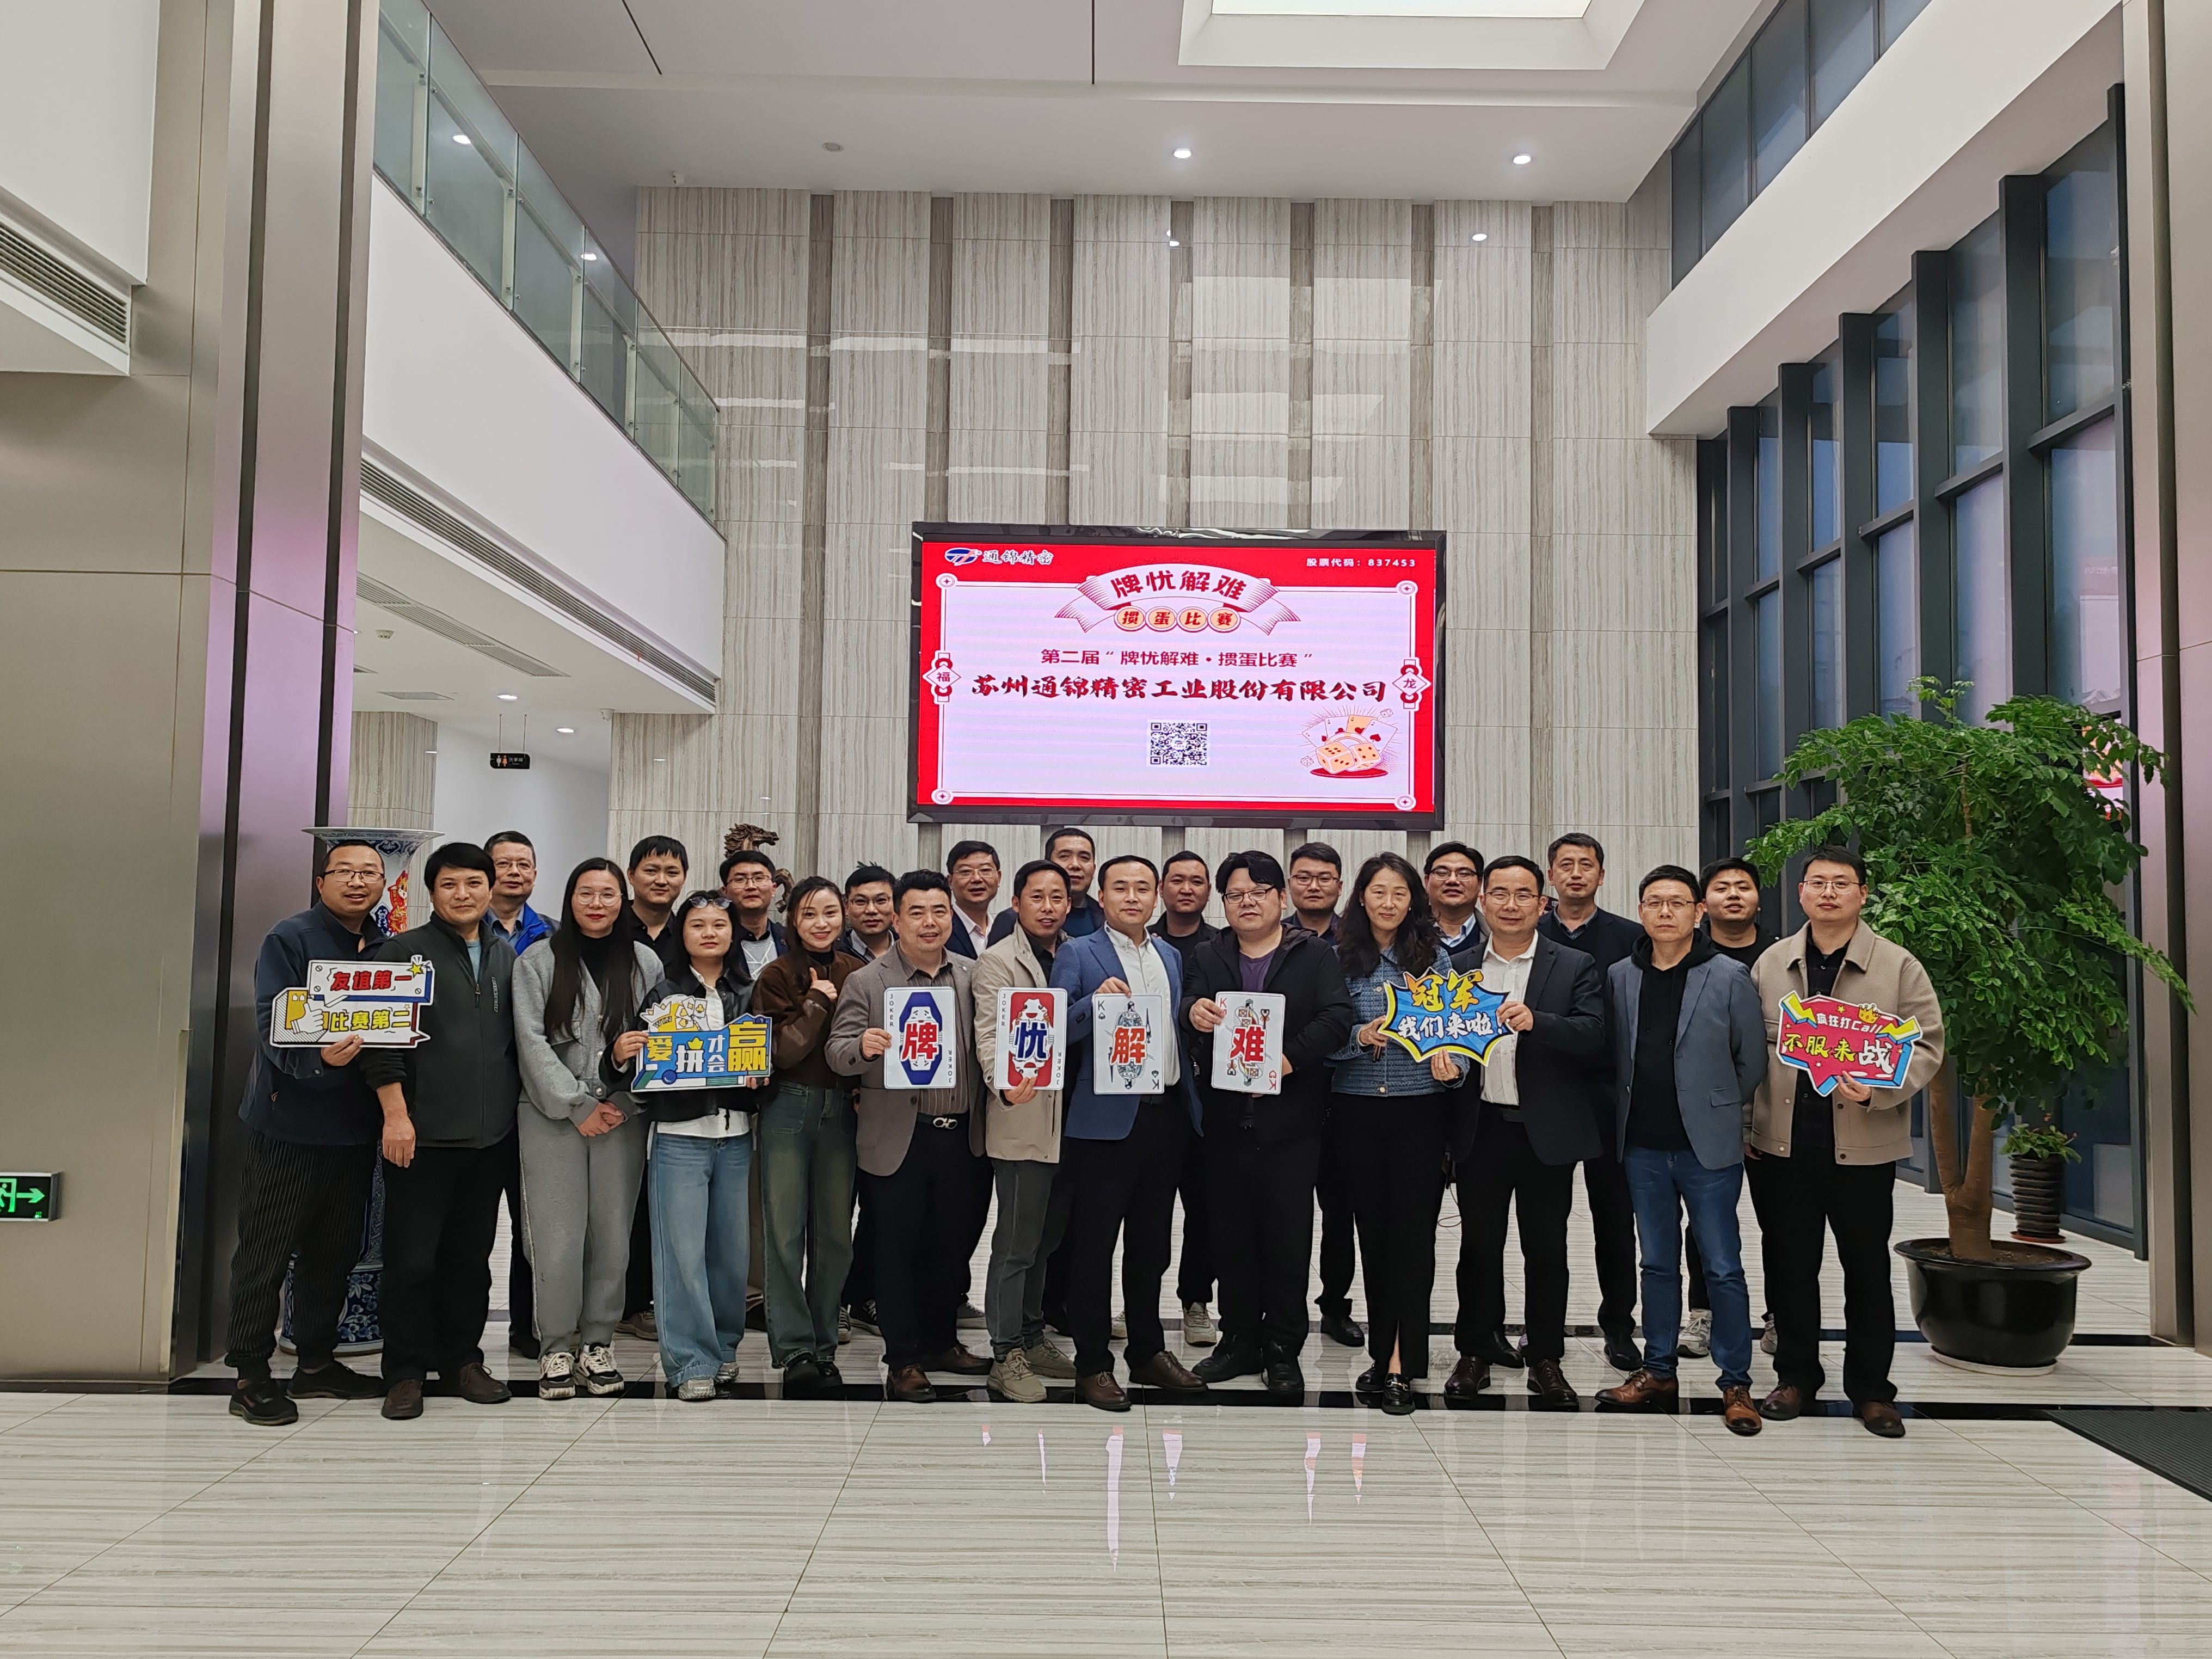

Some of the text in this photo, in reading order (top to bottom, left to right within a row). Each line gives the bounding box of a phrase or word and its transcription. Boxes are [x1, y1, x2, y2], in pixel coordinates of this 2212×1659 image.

[982, 549, 1054, 565] 通锦精密
[1110, 570, 1247, 600] 牌忧解难
[1122, 611, 1233, 626] 掼蛋比赛
[936, 671, 950, 682] 福
[1403, 678, 1417, 689] 龙
[972, 674, 1386, 702] 苏州通锦精密工业股份有限公司
[330, 970, 412, 991] 友谊第一
[1404, 969, 1484, 1013] 冠军
[1098, 1000, 1105, 1011] K
[1220, 998, 1227, 1007] K
[330, 1010, 411, 1032] 比赛第二
[653, 1016, 672, 1028] WIN
[1816, 1012, 1883, 1034] 疯狂打Call
[646, 1021, 767, 1073] 爱拼才会赢
[901, 1022, 937, 1059] 牌
[1015, 1022, 1047, 1059] 忧
[1111, 1027, 1145, 1064] 解
[1230, 1027, 1265, 1062] 难
[1784, 1033, 1895, 1074] 不服来战
[1152, 1079, 1160, 1090] K
[1269, 1079, 1277, 1090] K
